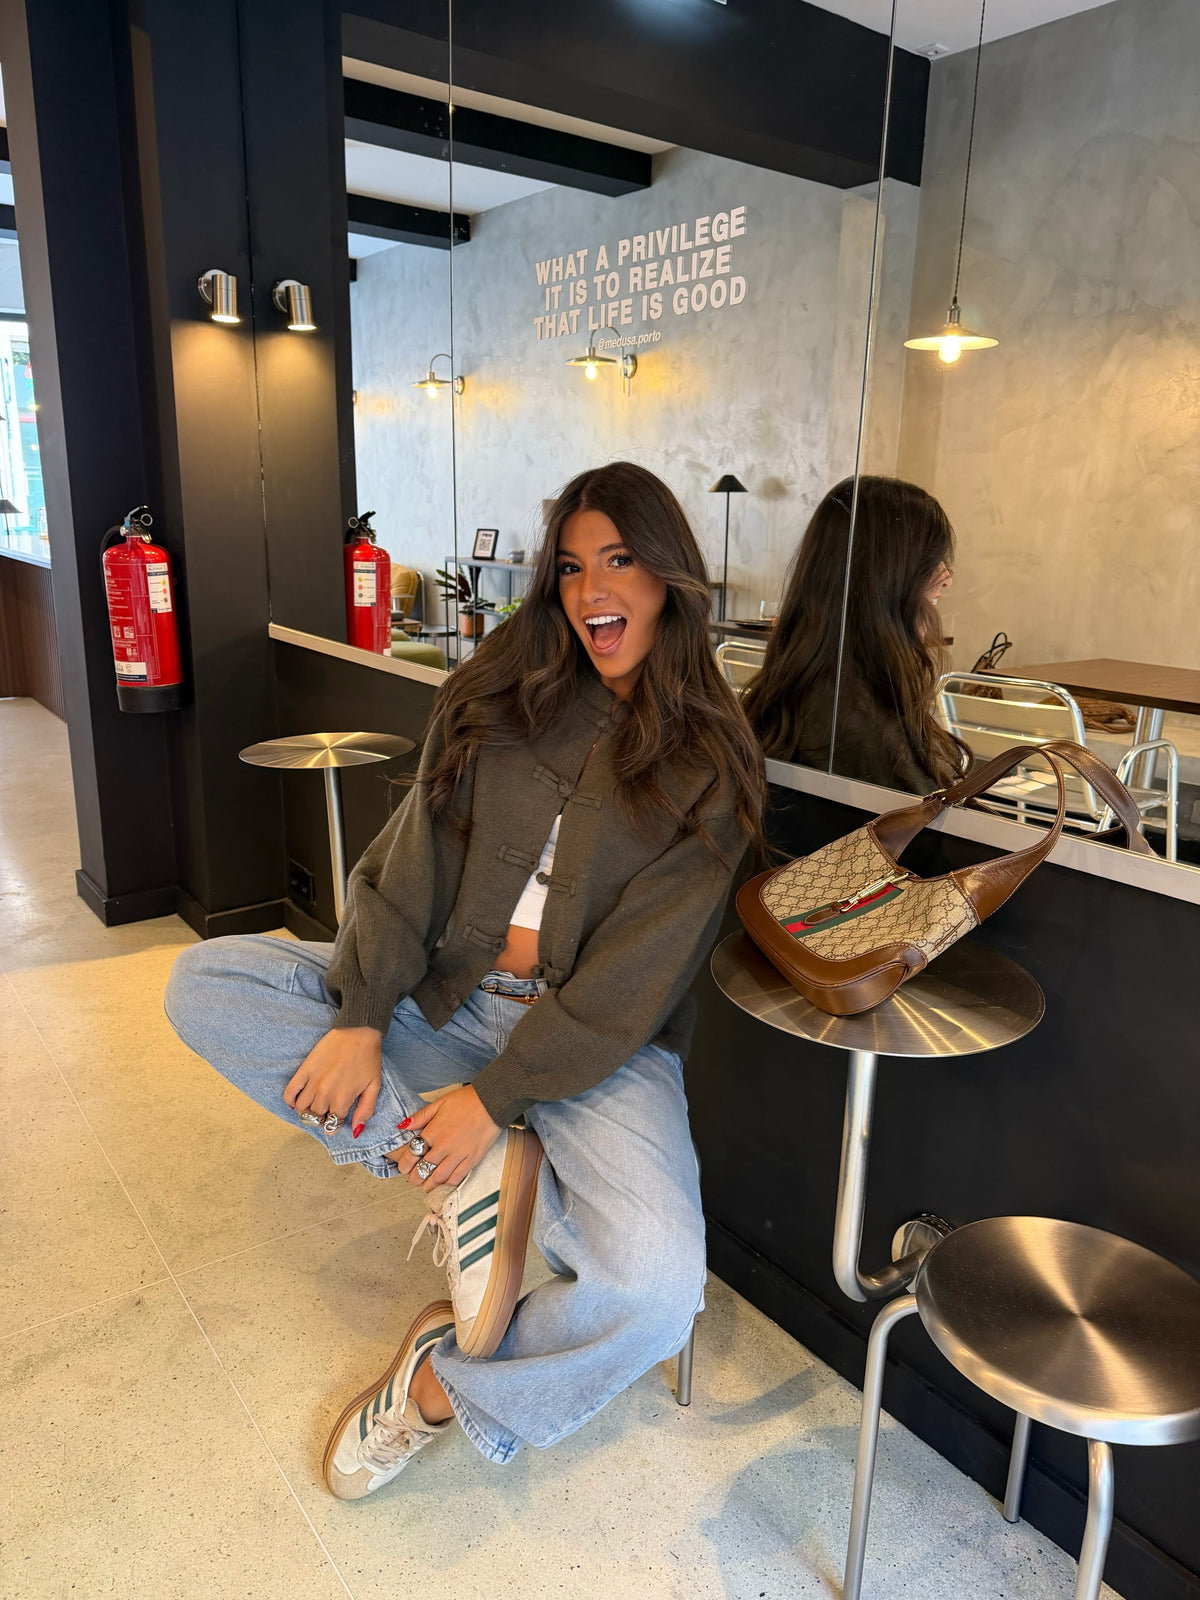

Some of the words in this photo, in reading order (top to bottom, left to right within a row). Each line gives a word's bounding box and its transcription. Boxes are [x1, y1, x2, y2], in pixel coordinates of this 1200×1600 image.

[536, 249, 588, 285] WHAT
[595, 245, 609, 272] A
[618, 206, 746, 266] PRIVILEGE
[545, 284, 562, 311] IT
[569, 279, 588, 307] IS
[593, 271, 620, 300] TO
[629, 245, 732, 293] REALIZE
[534, 309, 581, 340] THAT
[588, 298, 633, 331] LIFE
[641, 292, 663, 321] IS
[672, 275, 747, 316] GOOD
[598, 330, 661, 350] @medusa.porto
